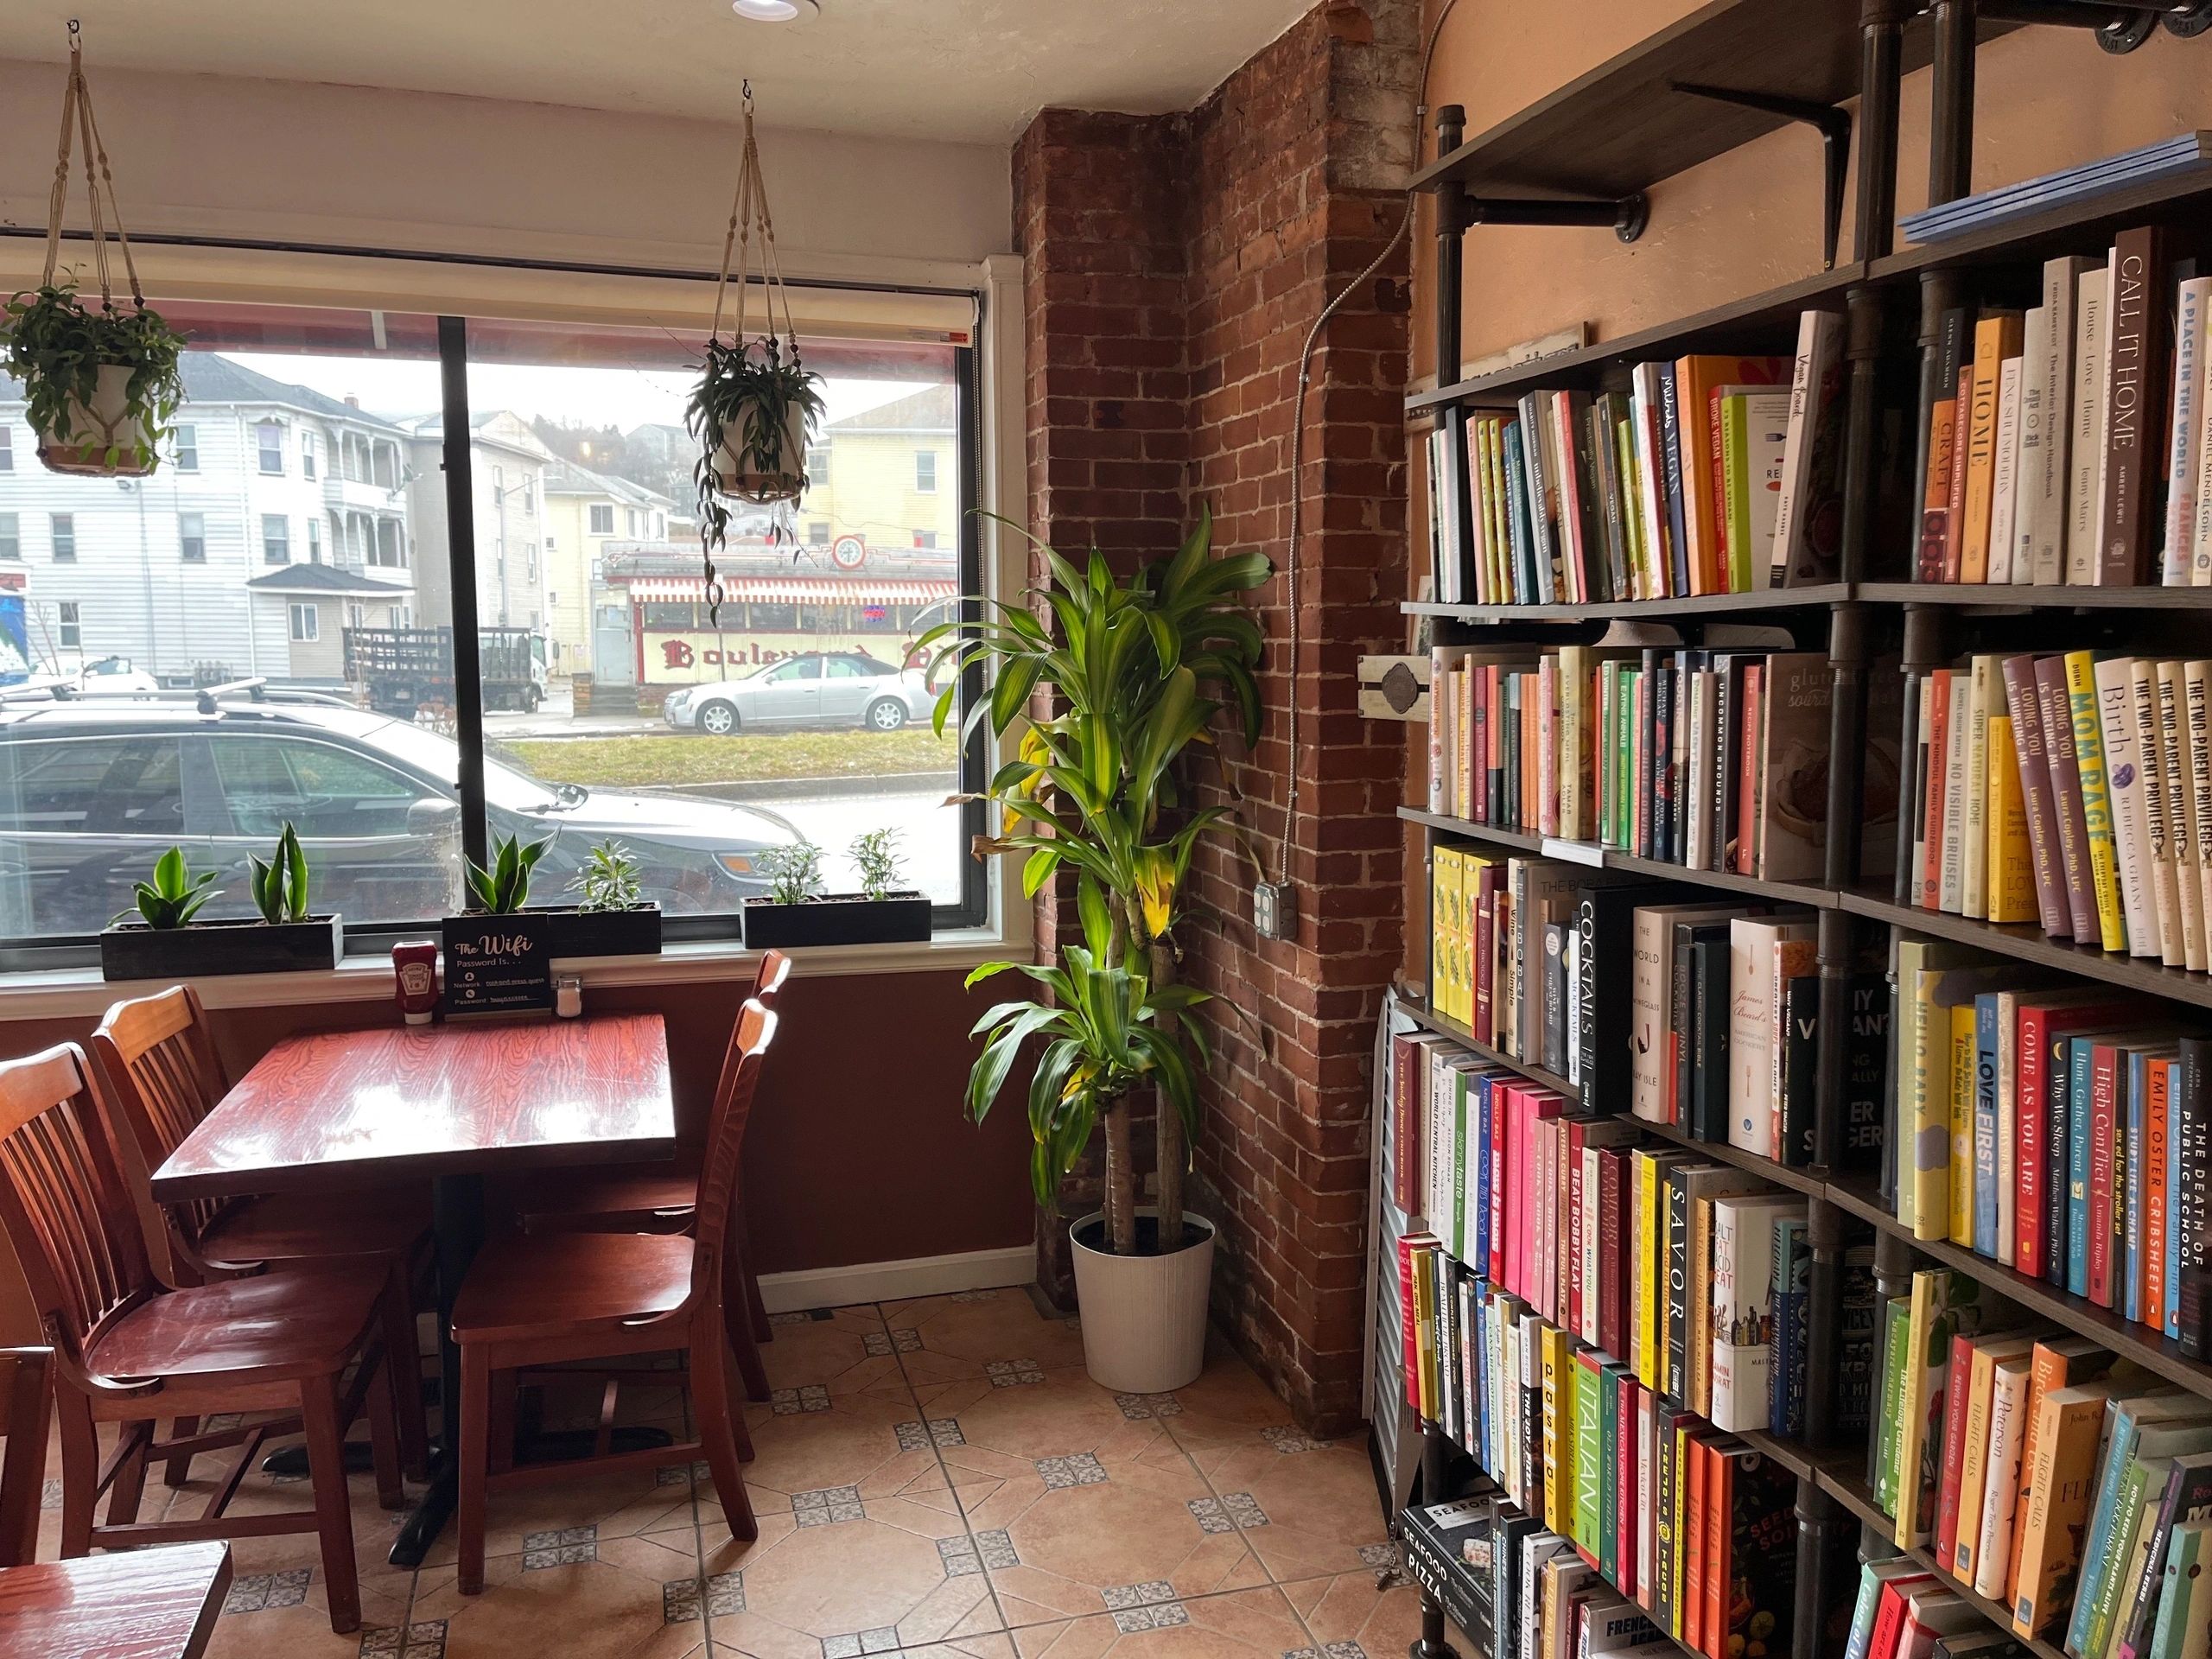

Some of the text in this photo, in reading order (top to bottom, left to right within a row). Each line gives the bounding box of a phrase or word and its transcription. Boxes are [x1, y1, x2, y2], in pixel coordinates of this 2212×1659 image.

[1796, 353, 1809, 385] Vegan
[2082, 300, 2098, 438] House Love Home
[2113, 255, 2143, 525] CALL IT HOME AMBER LEWIS
[1585, 416, 1596, 464] Practically
[1665, 432, 1679, 496] VEGAN
[1710, 397, 1721, 460] BROKE VEGAN
[1951, 382, 1967, 509] COTTAGECORE SIMPLIFIED
[1971, 379, 1993, 467] HOME
[2176, 307, 2196, 562] PLACE IN THE WORLD FRANCES
[1715, 683, 1726, 812] UNCOMMON GROUNDS
[2007, 681, 2029, 767] IS HURTING ME
[2020, 687, 2041, 756] LOVING YOU
[2037, 682, 2060, 771] IS HURTING ME
[2051, 688, 2073, 760] LOVING YOU
[2134, 678, 2164, 842] THE TWO-PARENT PRIVILEGE
[2158, 679, 2188, 846] THE TWO-PARENT PRIVILEGE
[2188, 678, 2210, 781] THE TWO-PARENT
[1930, 784, 1939, 811] FAMILY
[1968, 709, 1985, 827] SUPER HOME
[2102, 684, 2142, 912] Birth GRANT
[1945, 763, 1962, 888] NO VISIBLE BRUISES
[1509, 908, 1517, 936] Wine
[2042, 870, 2052, 887] LPC
[2071, 875, 2082, 893] LPC
[454, 933, 533, 957] The Wifi
[456, 958, 496, 968] Password
[1580, 899, 1594, 1036] COCKTAILS
[1733, 989, 1764, 1005] James
[1916, 1001, 1928, 1058] HELLO
[1643, 1072, 1657, 1087] ISLE
[1678, 1027, 1687, 1064] VINYL
[1976, 1050, 1995, 1175] LOVE FIRST
[2020, 1021, 2036, 1196] COME AS YOU ARE
[2050, 1073, 2064, 1203] Why We Sleep Matthew
[2074, 1135, 2085, 1173] Parent
[2093, 1066, 2110, 1272] High Conflict Amanda Ripley
[2114, 1160, 2124, 1173] for
[2114, 1174, 2123, 1188] the
[2127, 1127, 2139, 1250] STUDY LIKE CHAMP
[2147, 1071, 2165, 1294] EMILY OSTER CRIBSHEET
[2181, 1110, 2191, 1269] PUBLIC SCHOOL
[2192, 1123, 2207, 1266] THE DEATH OF
[1571, 1167, 1580, 1294] BEAT BOBBY FLAY
[1669, 1186, 1685, 1319] SAVOR
[1662, 1305, 1670, 1354] Kitchen
[1523, 1418, 1532, 1443] JOY
[1545, 1362, 1554, 1479] pasta
[1580, 1383, 1597, 1511] ITALIAN
[1948, 1374, 1962, 1468] REWILD YOUR GARDEN
[1970, 1402, 1982, 1444] FLIGHT
[1993, 1399, 2012, 1459] Peterson
[1523, 1451, 1532, 1487] PIZZA
[2036, 1451, 2050, 1492] FLIGHT
[1403, 1526, 1448, 1582] SEAFOOD
[1408, 1553, 1442, 1604] PIZZA
[2101, 1483, 2139, 1615] HOW TO KEEP YOUR PLANTS ALIVE
